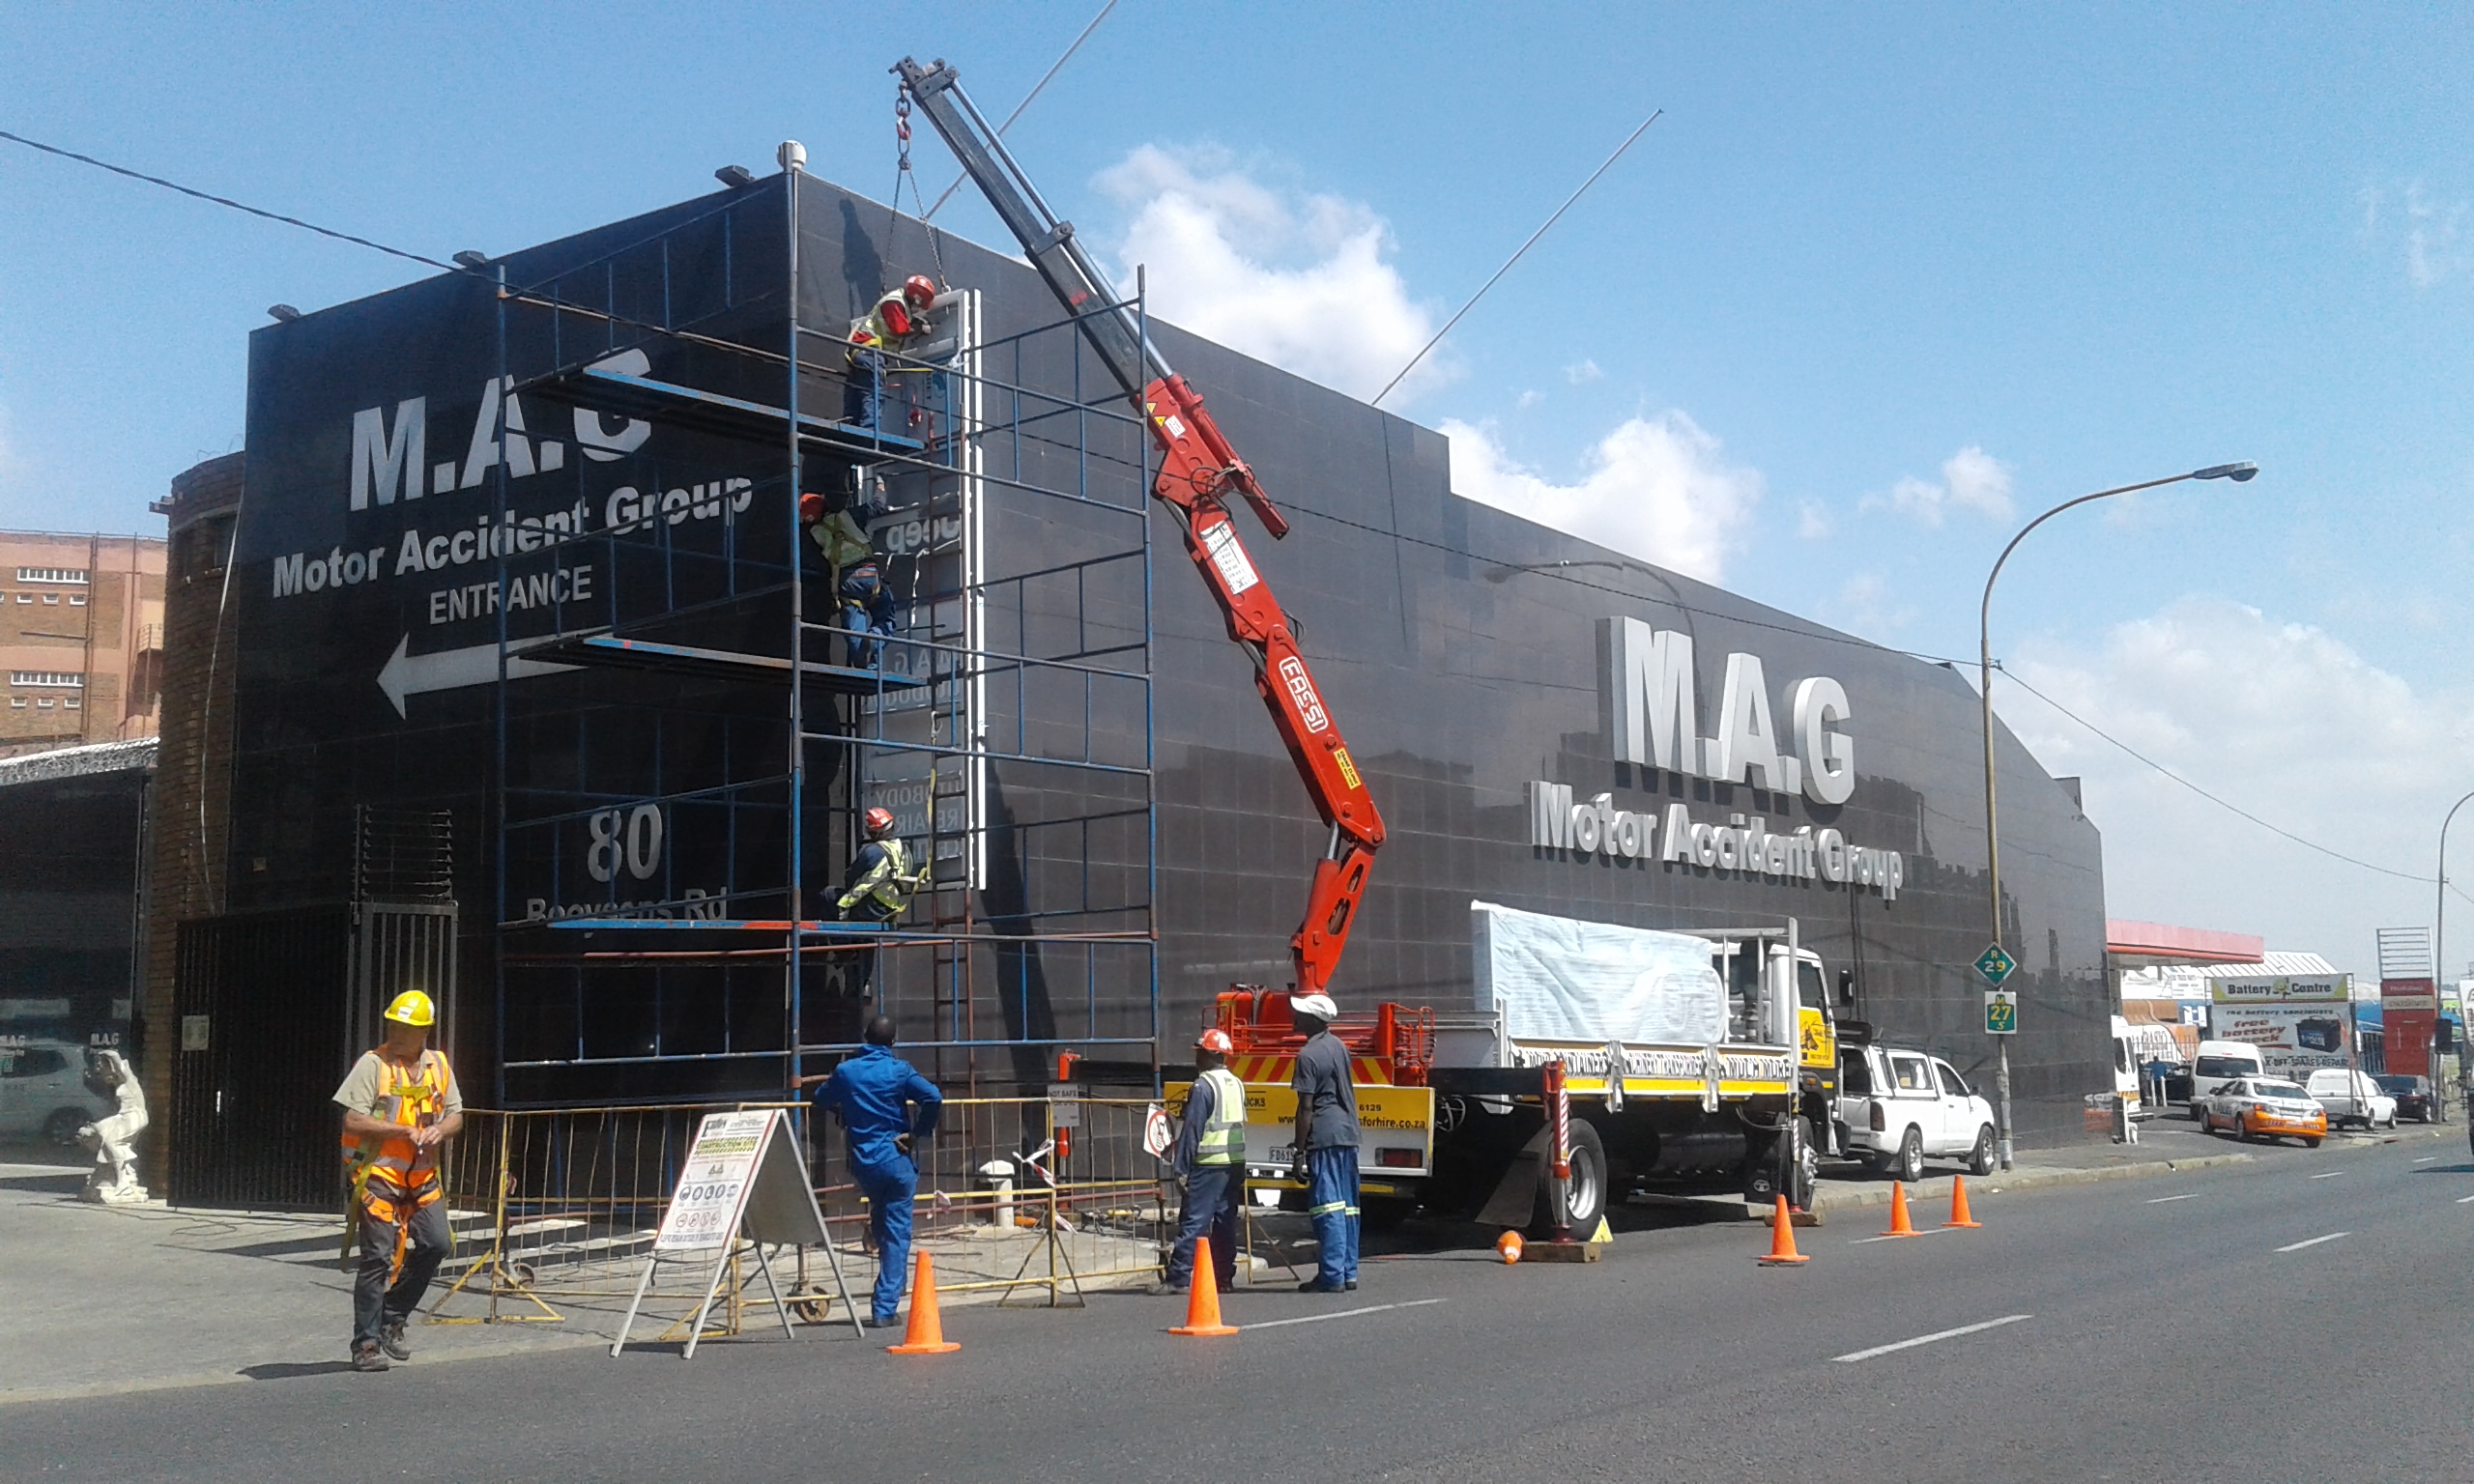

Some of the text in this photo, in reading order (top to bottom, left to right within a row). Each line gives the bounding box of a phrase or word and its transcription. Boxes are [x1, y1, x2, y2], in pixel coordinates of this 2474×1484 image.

[273, 475, 753, 598] Motor Accident Group
[430, 565, 592, 625] ENTRANCE
[1283, 662, 1324, 728] FASSI
[1611, 615, 1856, 805] M.A.G
[588, 803, 663, 882] 80
[1531, 781, 1904, 900] Motor Accident Group
[684, 887, 728, 921] Rd
[1984, 960, 2007, 973] 29
[1991, 950, 1999, 959] R
[1997, 996, 2005, 1005] M
[2227, 983, 2332, 996] Battery Centre
[1991, 1006, 2011, 1021] 27
